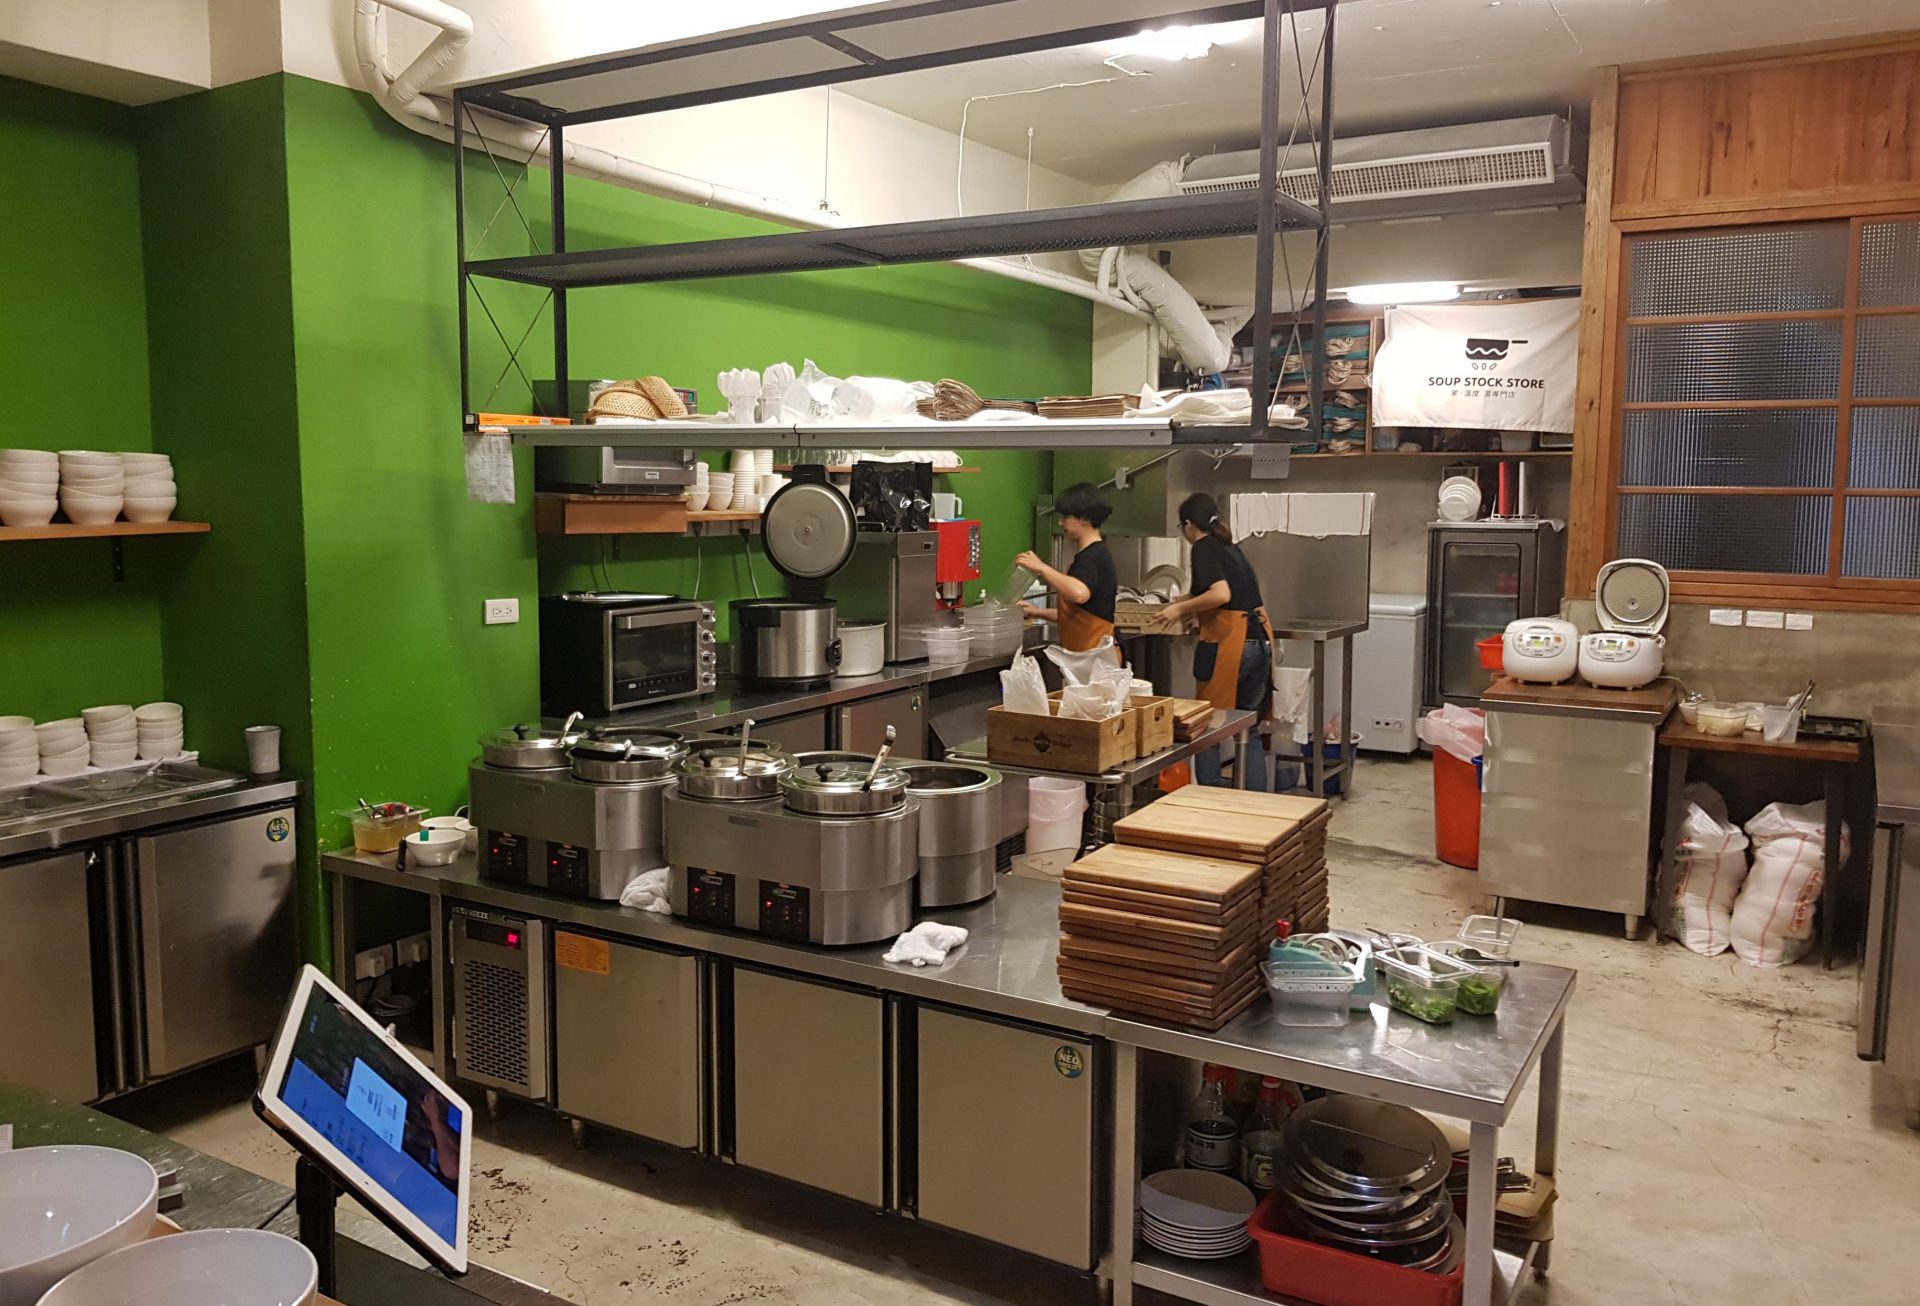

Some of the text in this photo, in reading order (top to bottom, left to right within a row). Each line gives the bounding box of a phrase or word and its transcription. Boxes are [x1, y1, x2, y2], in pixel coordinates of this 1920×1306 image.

[1428, 377, 1545, 389] SOUP STOCK STORE
[1059, 1053, 1078, 1064] NEO
